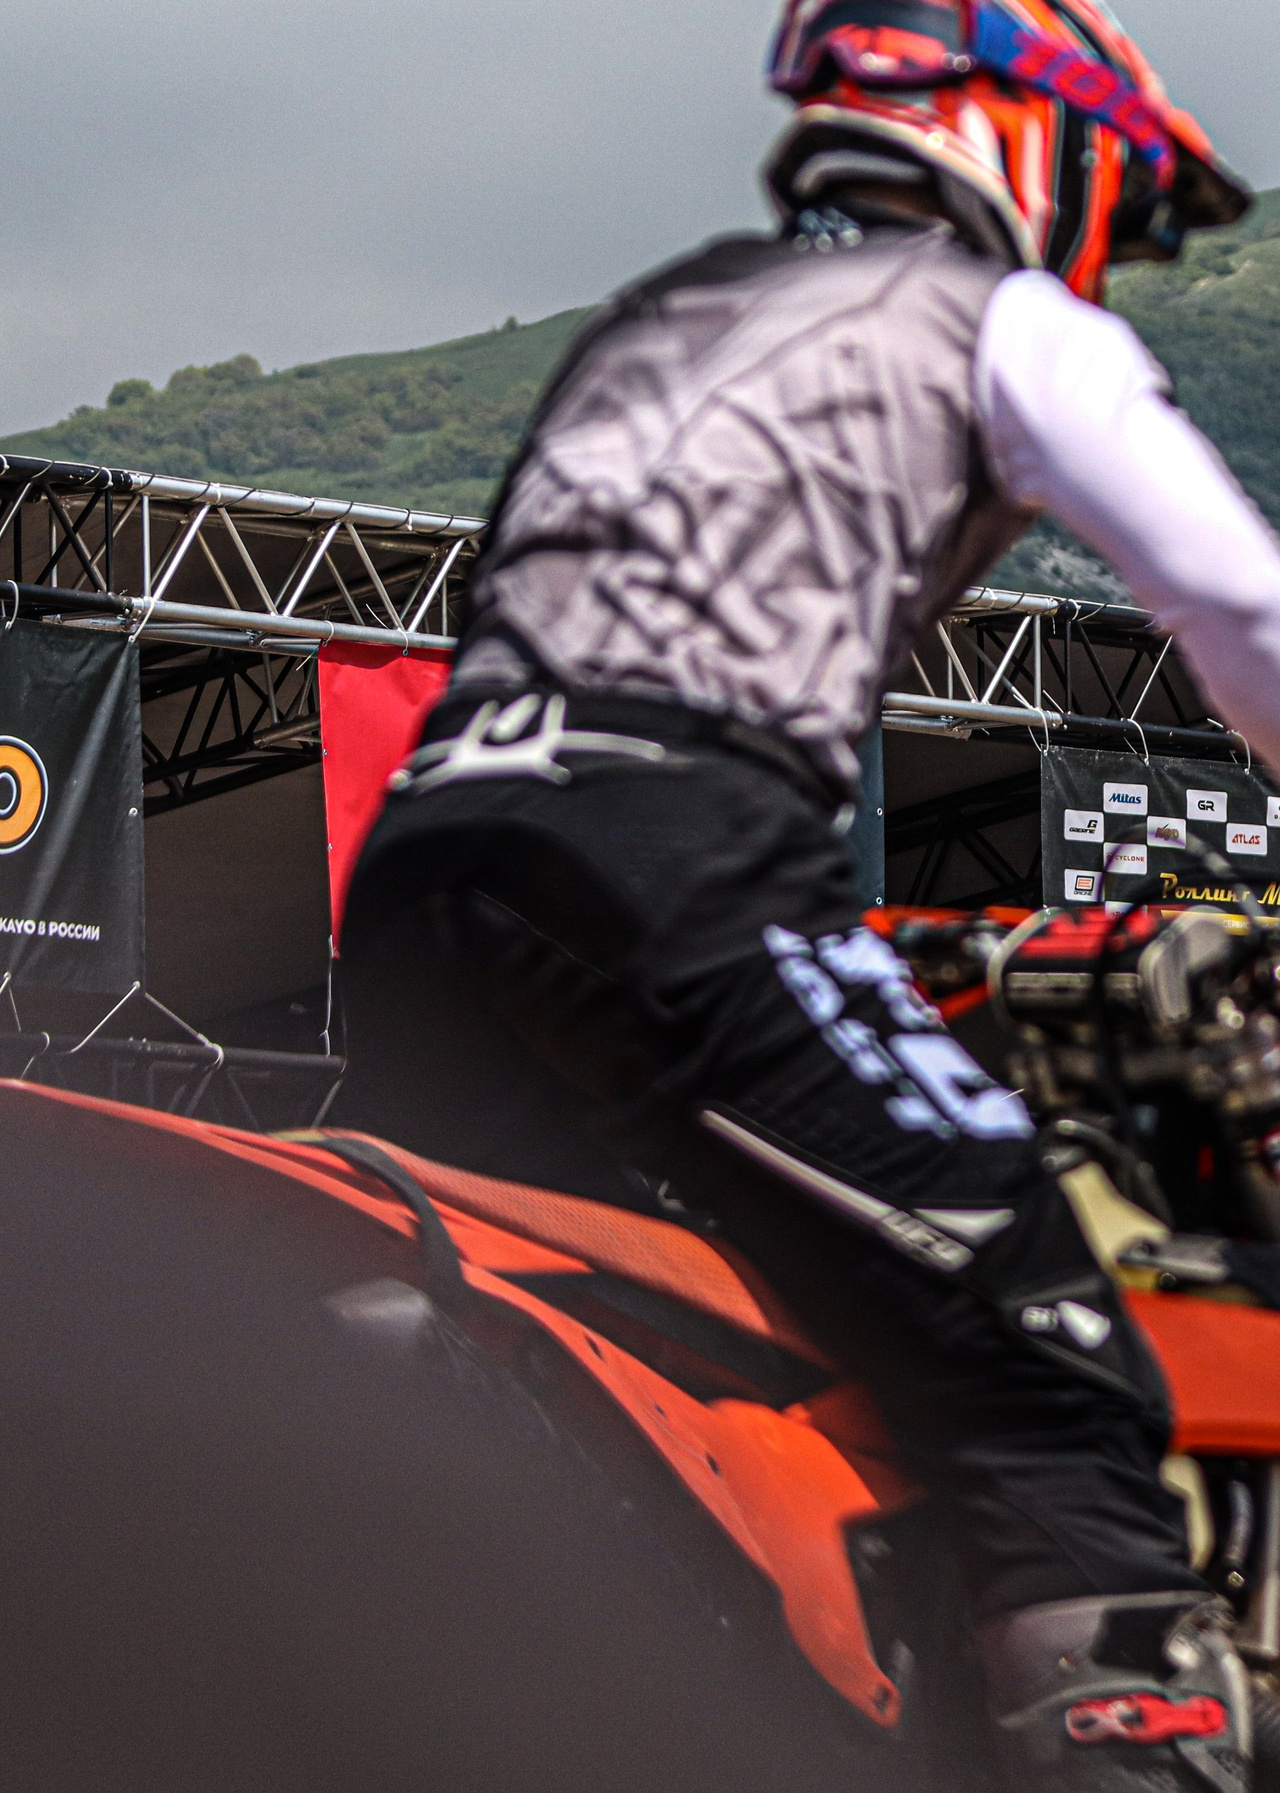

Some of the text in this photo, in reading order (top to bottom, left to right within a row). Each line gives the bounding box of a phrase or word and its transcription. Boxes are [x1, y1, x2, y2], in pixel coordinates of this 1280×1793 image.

[1108, 793, 1142, 804] Mitas
[1197, 800, 1215, 812] GR
[1231, 833, 1260, 845] ATLAS
[48, 921, 100, 941] РОССИИ
